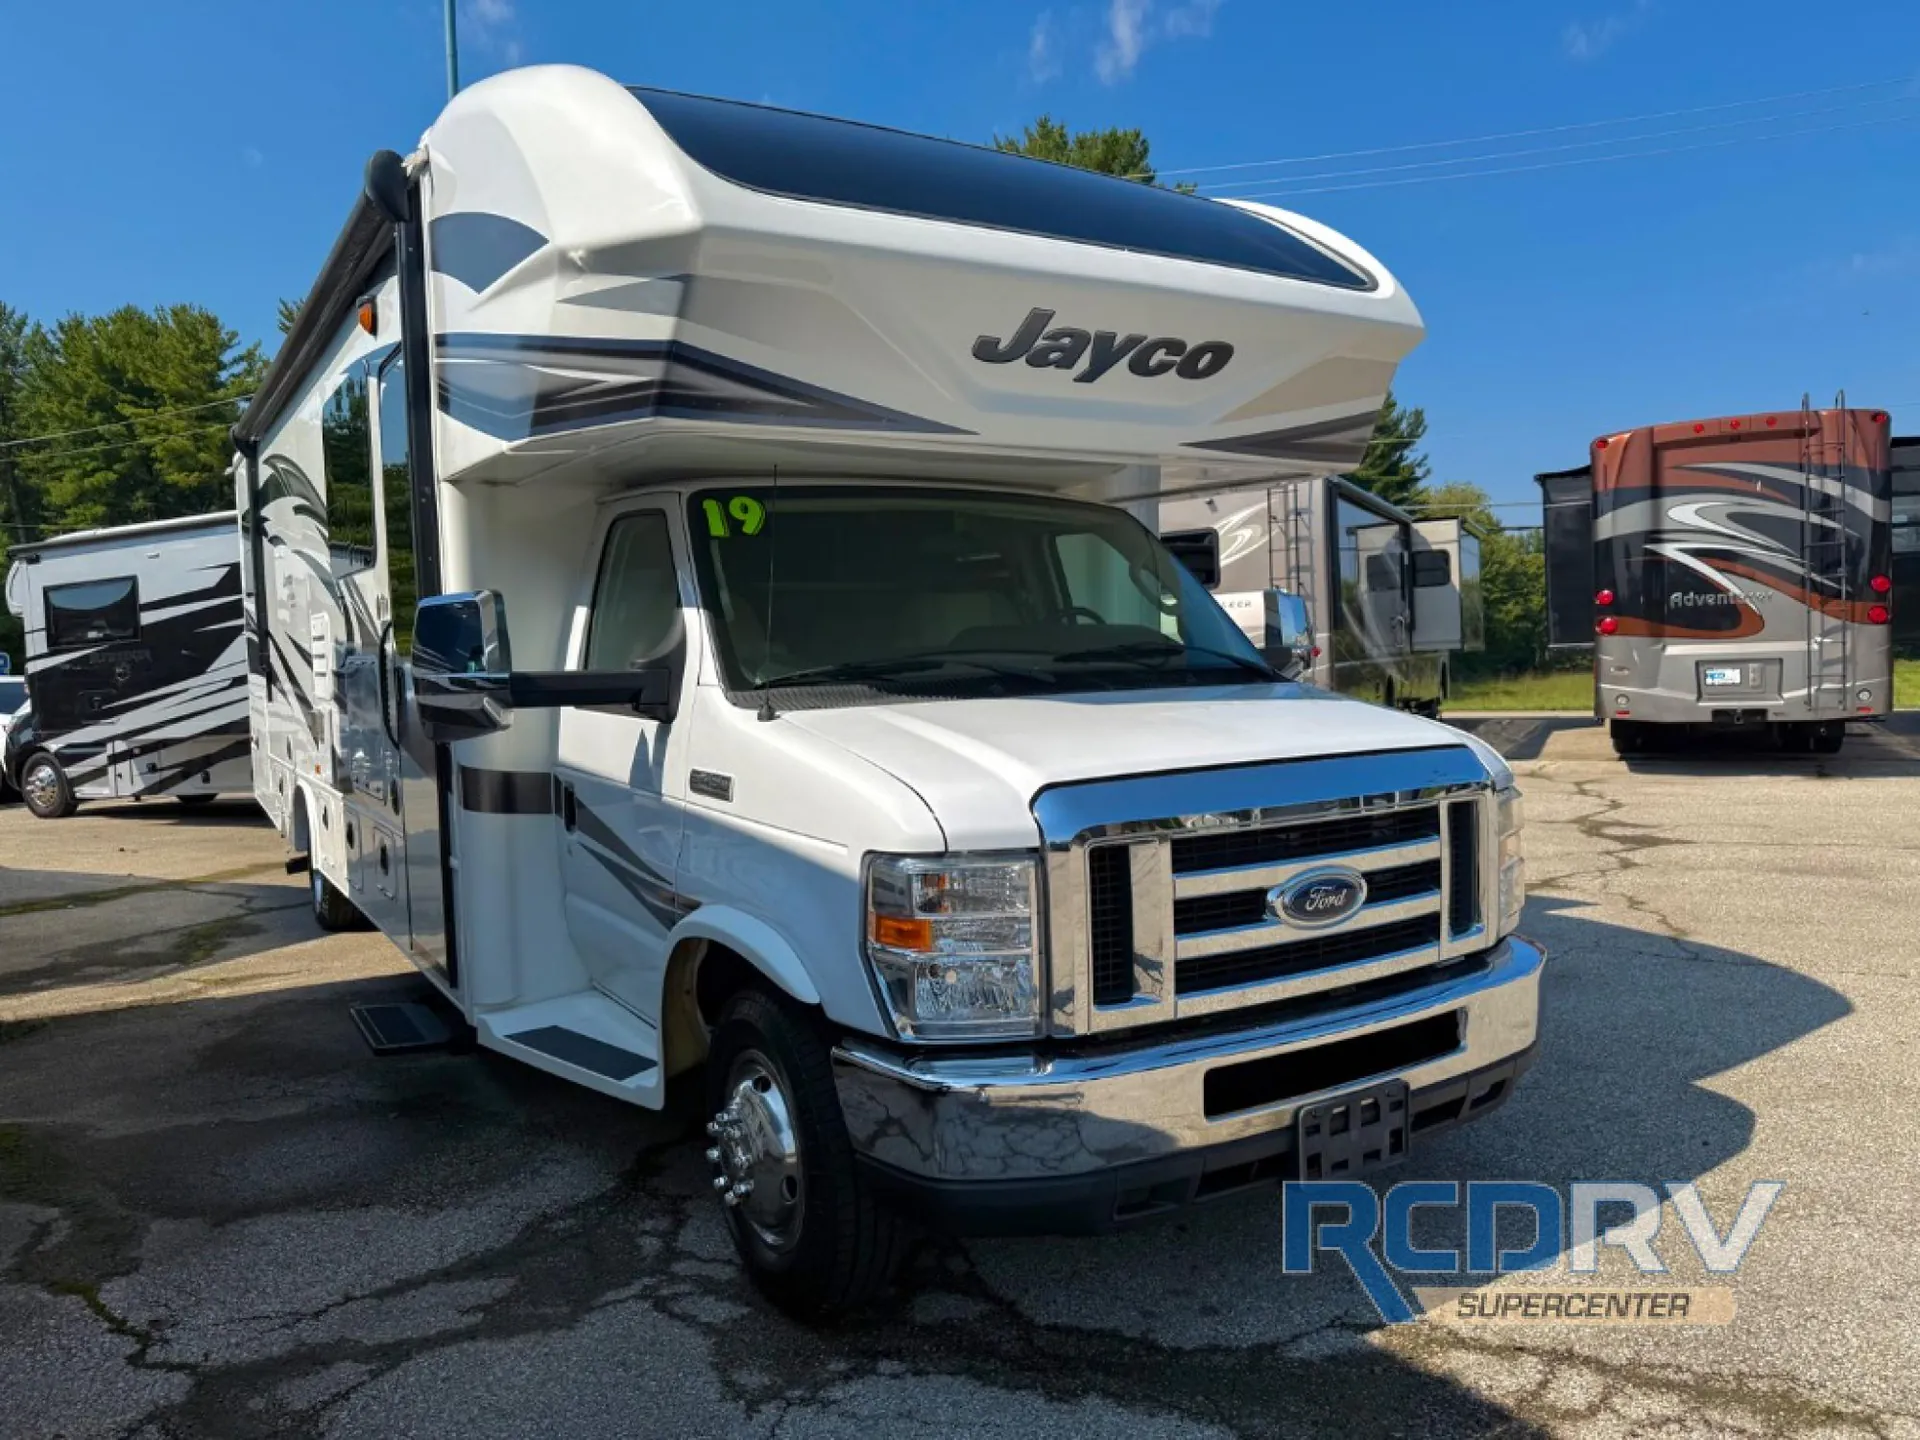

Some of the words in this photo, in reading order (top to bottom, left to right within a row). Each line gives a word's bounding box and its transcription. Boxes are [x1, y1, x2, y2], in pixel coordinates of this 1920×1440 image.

[971, 306, 1234, 383] Jayco
[702, 496, 766, 537] 19
[1305, 886, 1348, 911] Ford
